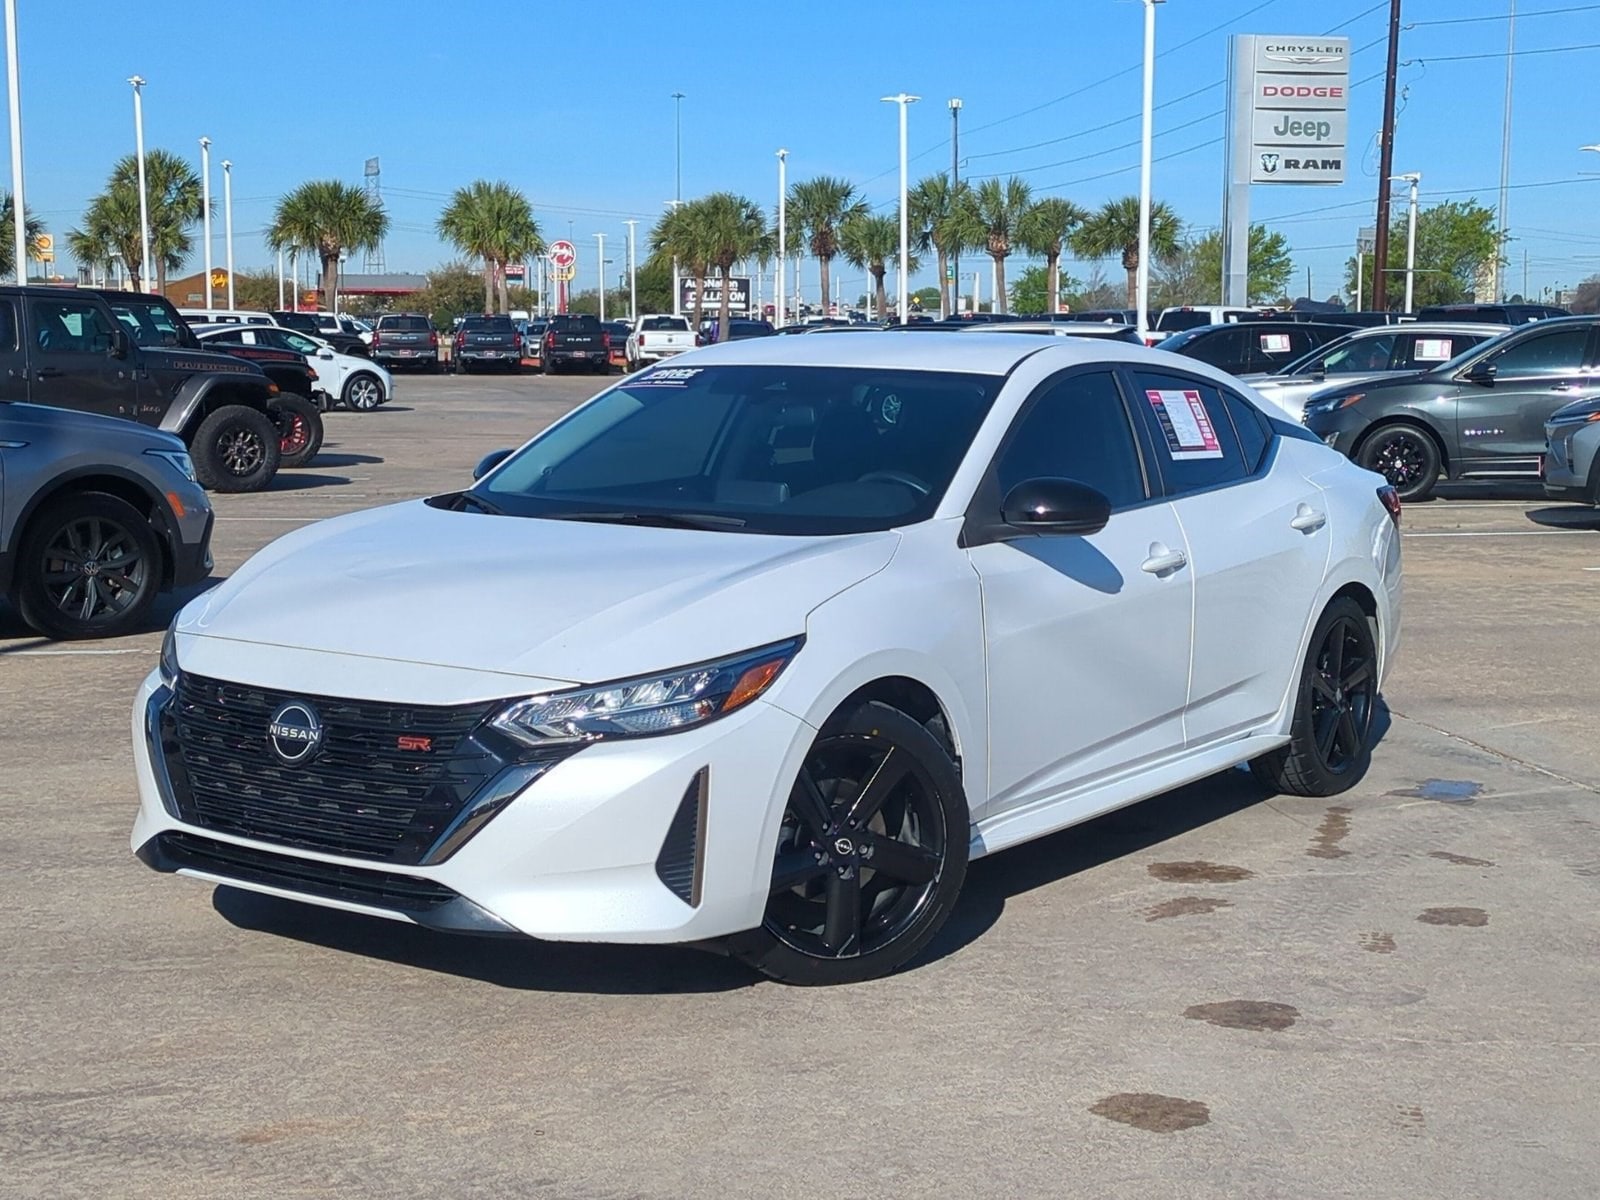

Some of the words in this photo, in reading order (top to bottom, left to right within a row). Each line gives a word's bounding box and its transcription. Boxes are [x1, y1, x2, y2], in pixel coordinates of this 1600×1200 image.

[1265, 45, 1344, 54] CHRYSLER
[1263, 86, 1343, 98] DODGE
[1273, 115, 1331, 141] Jeep
[1284, 158, 1342, 170] RAM
[269, 724, 319, 741] NISSAN
[397, 736, 432, 751] SR
